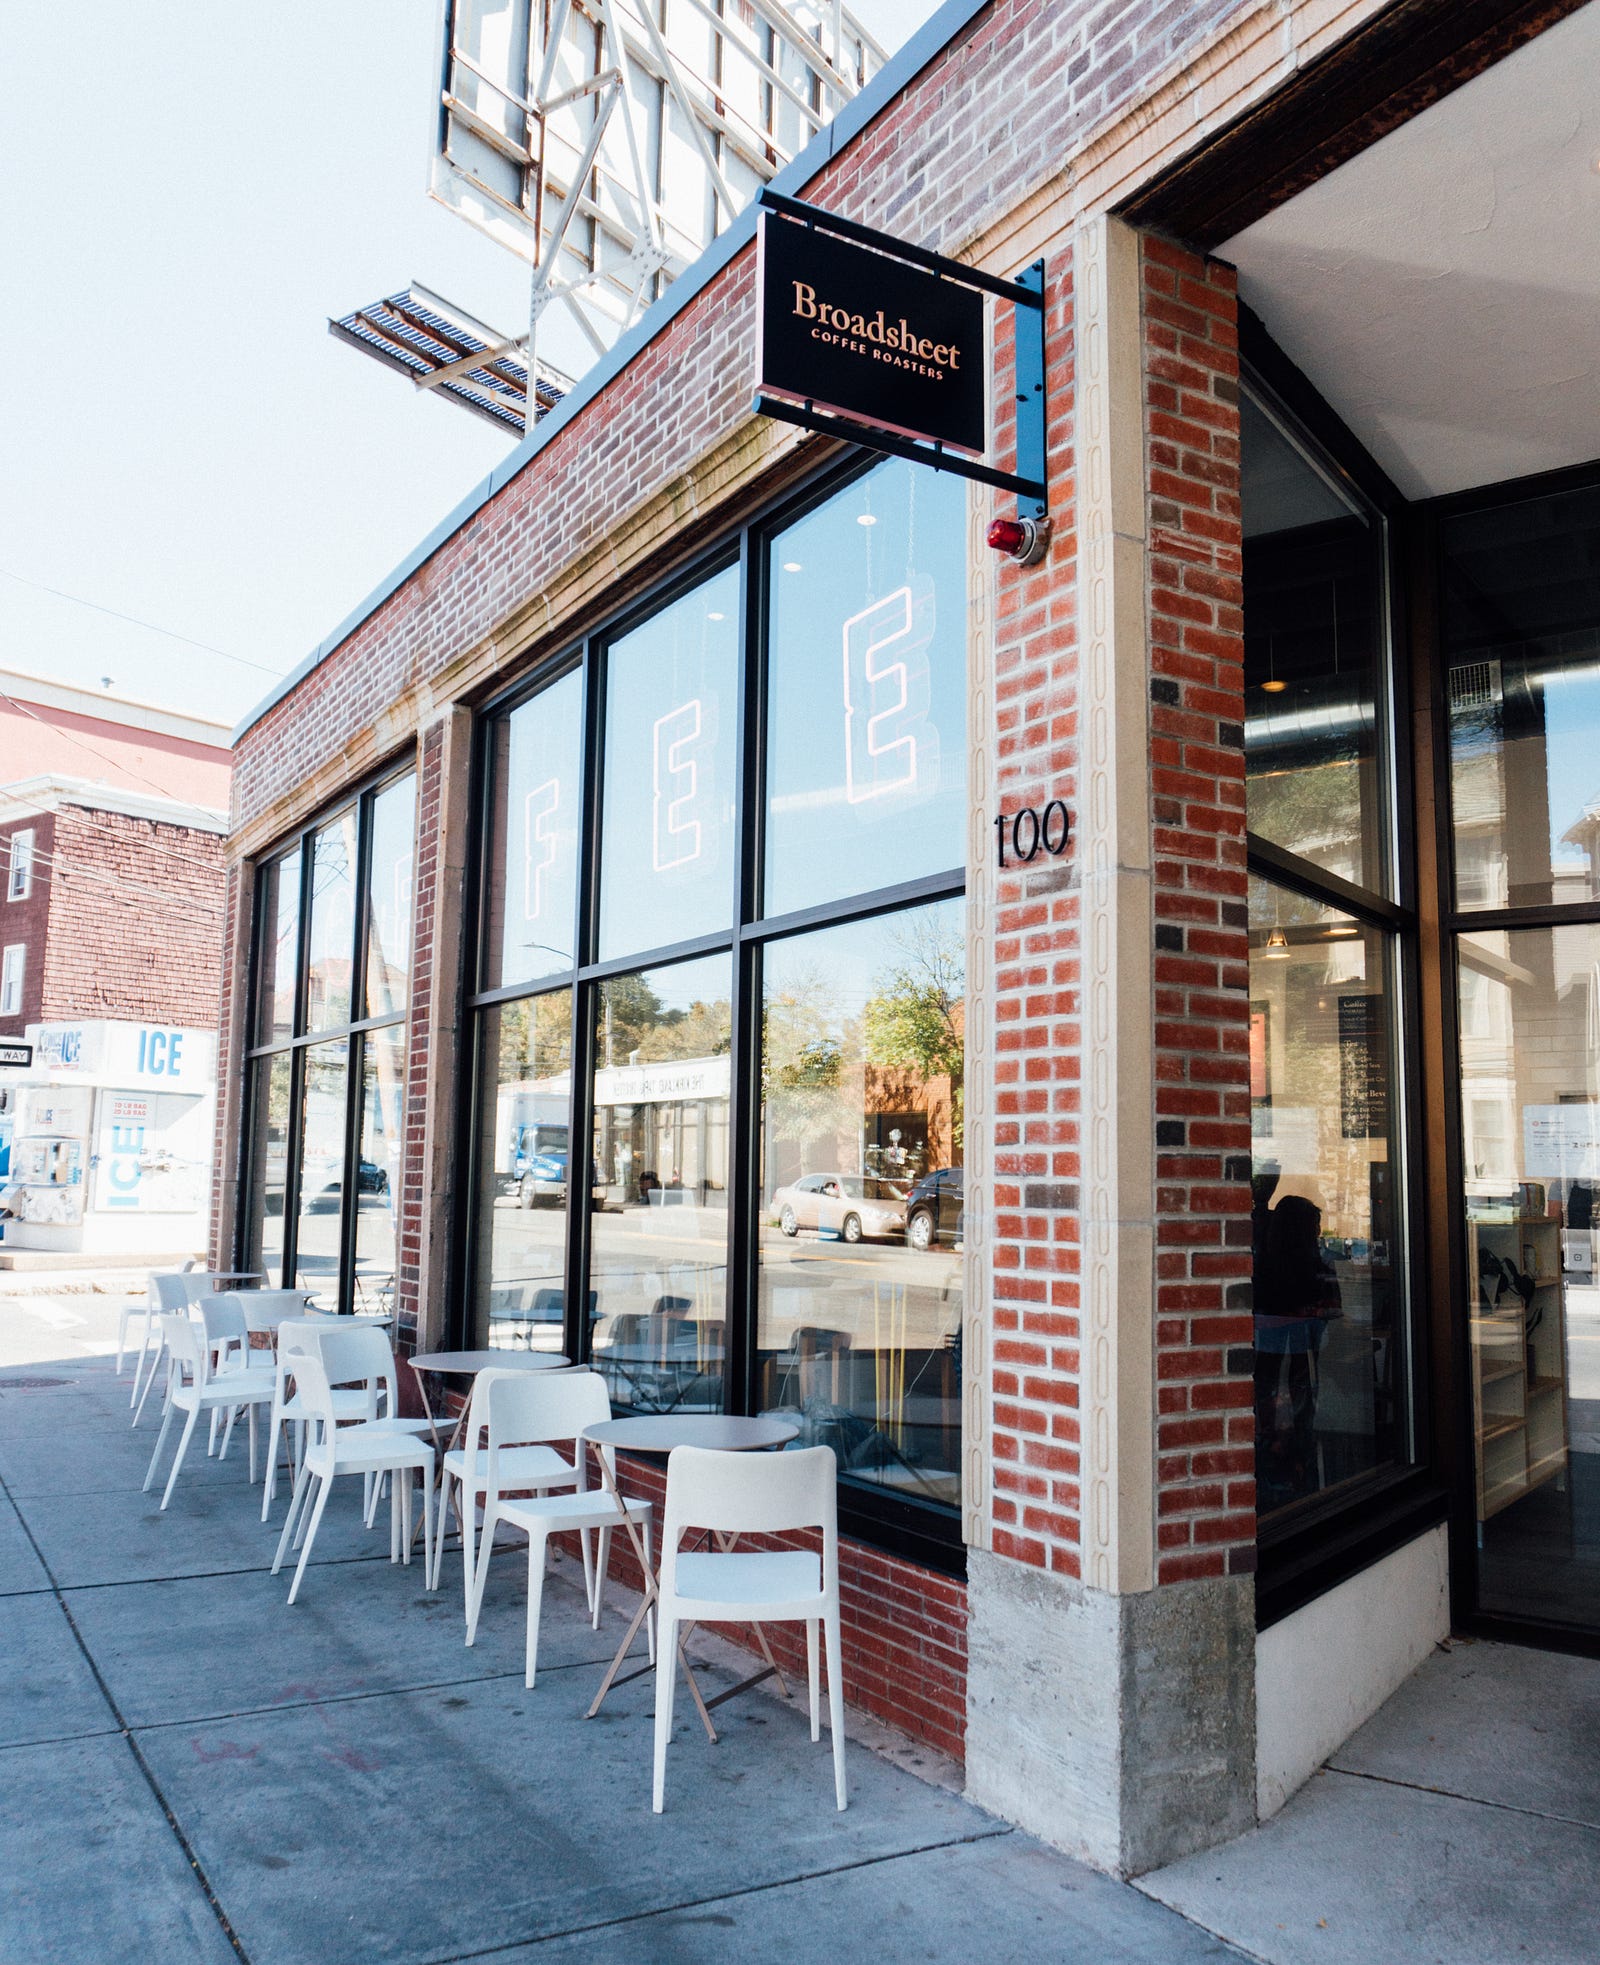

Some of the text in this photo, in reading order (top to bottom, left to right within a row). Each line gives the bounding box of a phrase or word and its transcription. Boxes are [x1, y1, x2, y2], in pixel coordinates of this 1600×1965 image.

[792, 280, 960, 370] Broadsheet
[811, 328, 943, 381] COFFEE ROASTERS
[994, 800, 1069, 868] 100
[3, 1050, 27, 1061] WAY
[61, 1031, 82, 1062] ICE
[138, 1030, 183, 1076] ICE
[107, 1126, 144, 1206] ICE
